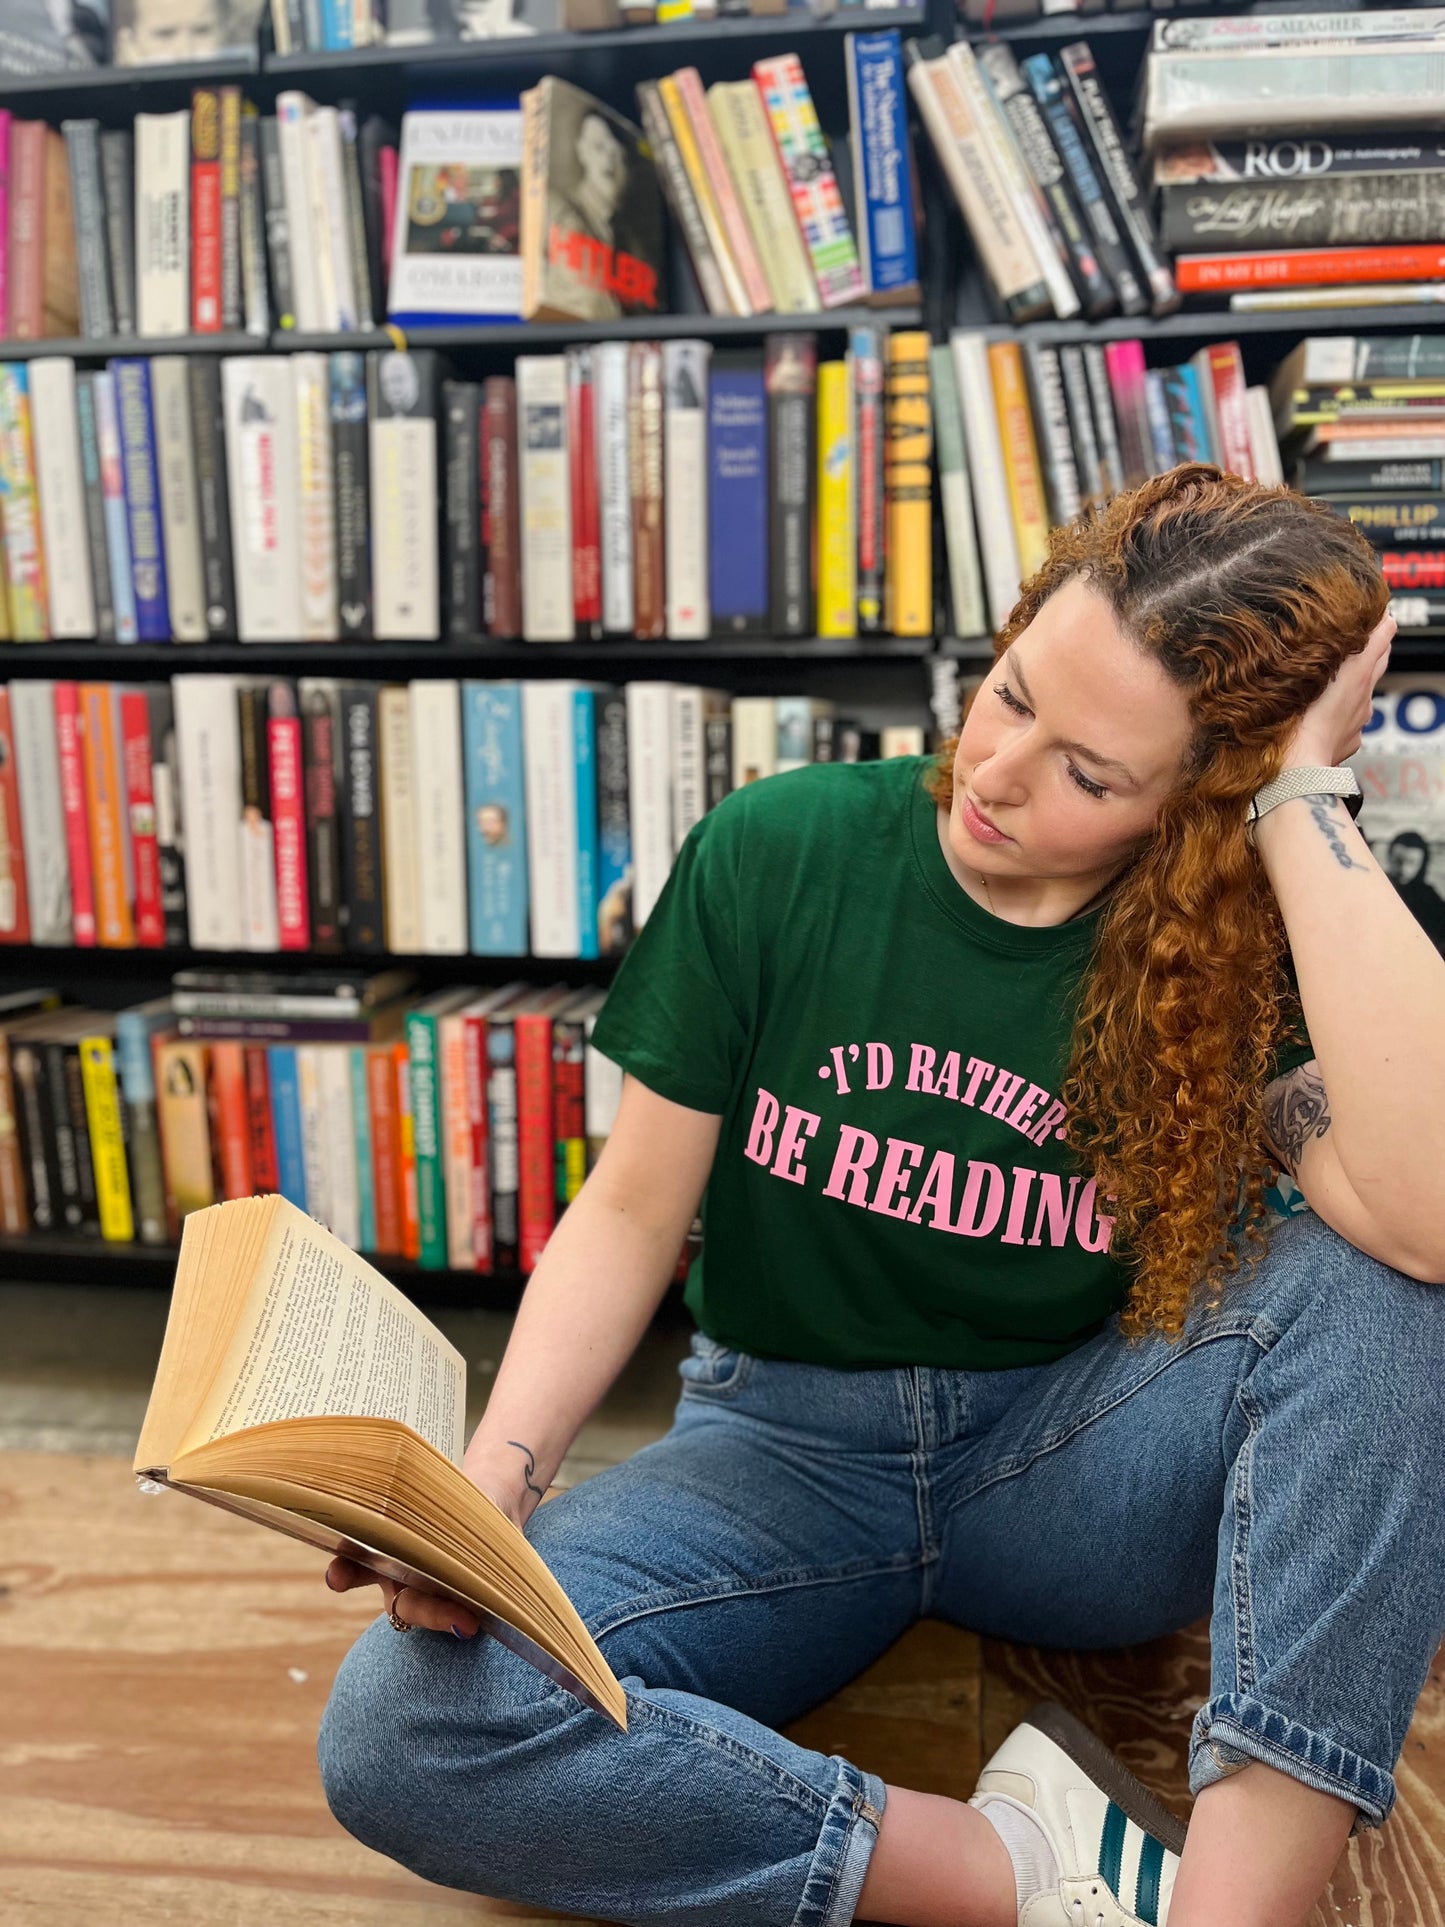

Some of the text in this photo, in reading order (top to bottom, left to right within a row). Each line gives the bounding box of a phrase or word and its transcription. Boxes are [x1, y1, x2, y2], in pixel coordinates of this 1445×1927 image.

[1265, 17, 1364, 35] GALLAGHER
[1243, 140, 1333, 178] ROD
[549, 223, 661, 312] HITLER
[1254, 261, 1289, 278] LIFE
[1349, 504, 1438, 526] PHILLIP
[744, 1088, 1118, 1255] BE READING
[228, 1380, 239, 1404] private
[238, 1354, 249, 1379] garages
[237, 1385, 246, 1403] order
[261, 1318, 271, 1341] enough
[256, 1373, 266, 1395] always
[265, 1355, 273, 1371] went
[273, 1375, 281, 1393] speak
